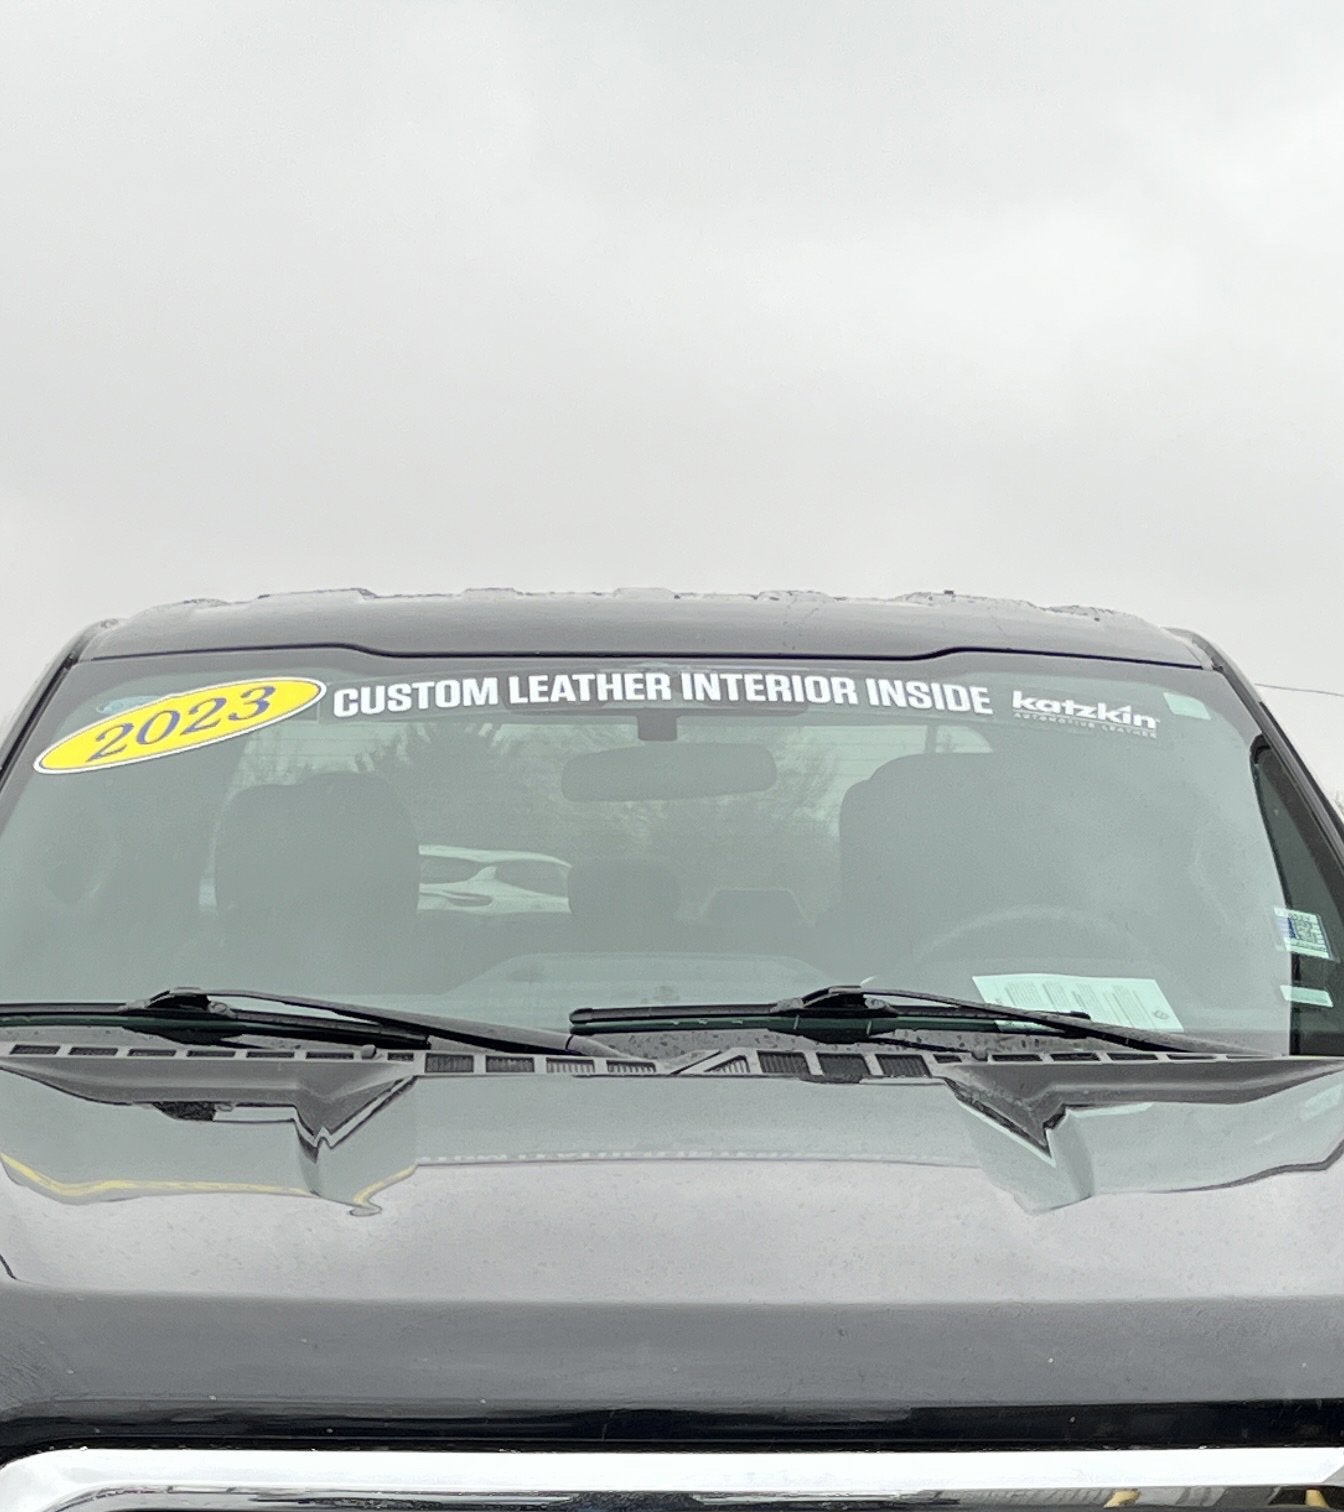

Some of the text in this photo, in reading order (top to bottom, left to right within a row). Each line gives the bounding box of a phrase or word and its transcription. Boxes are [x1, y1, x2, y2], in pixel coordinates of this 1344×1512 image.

[333, 672, 994, 718] CUSTOM LEATHER INTERIOR INSIDE
[1012, 690, 1157, 729] katzkin
[85, 685, 277, 763] 2023
